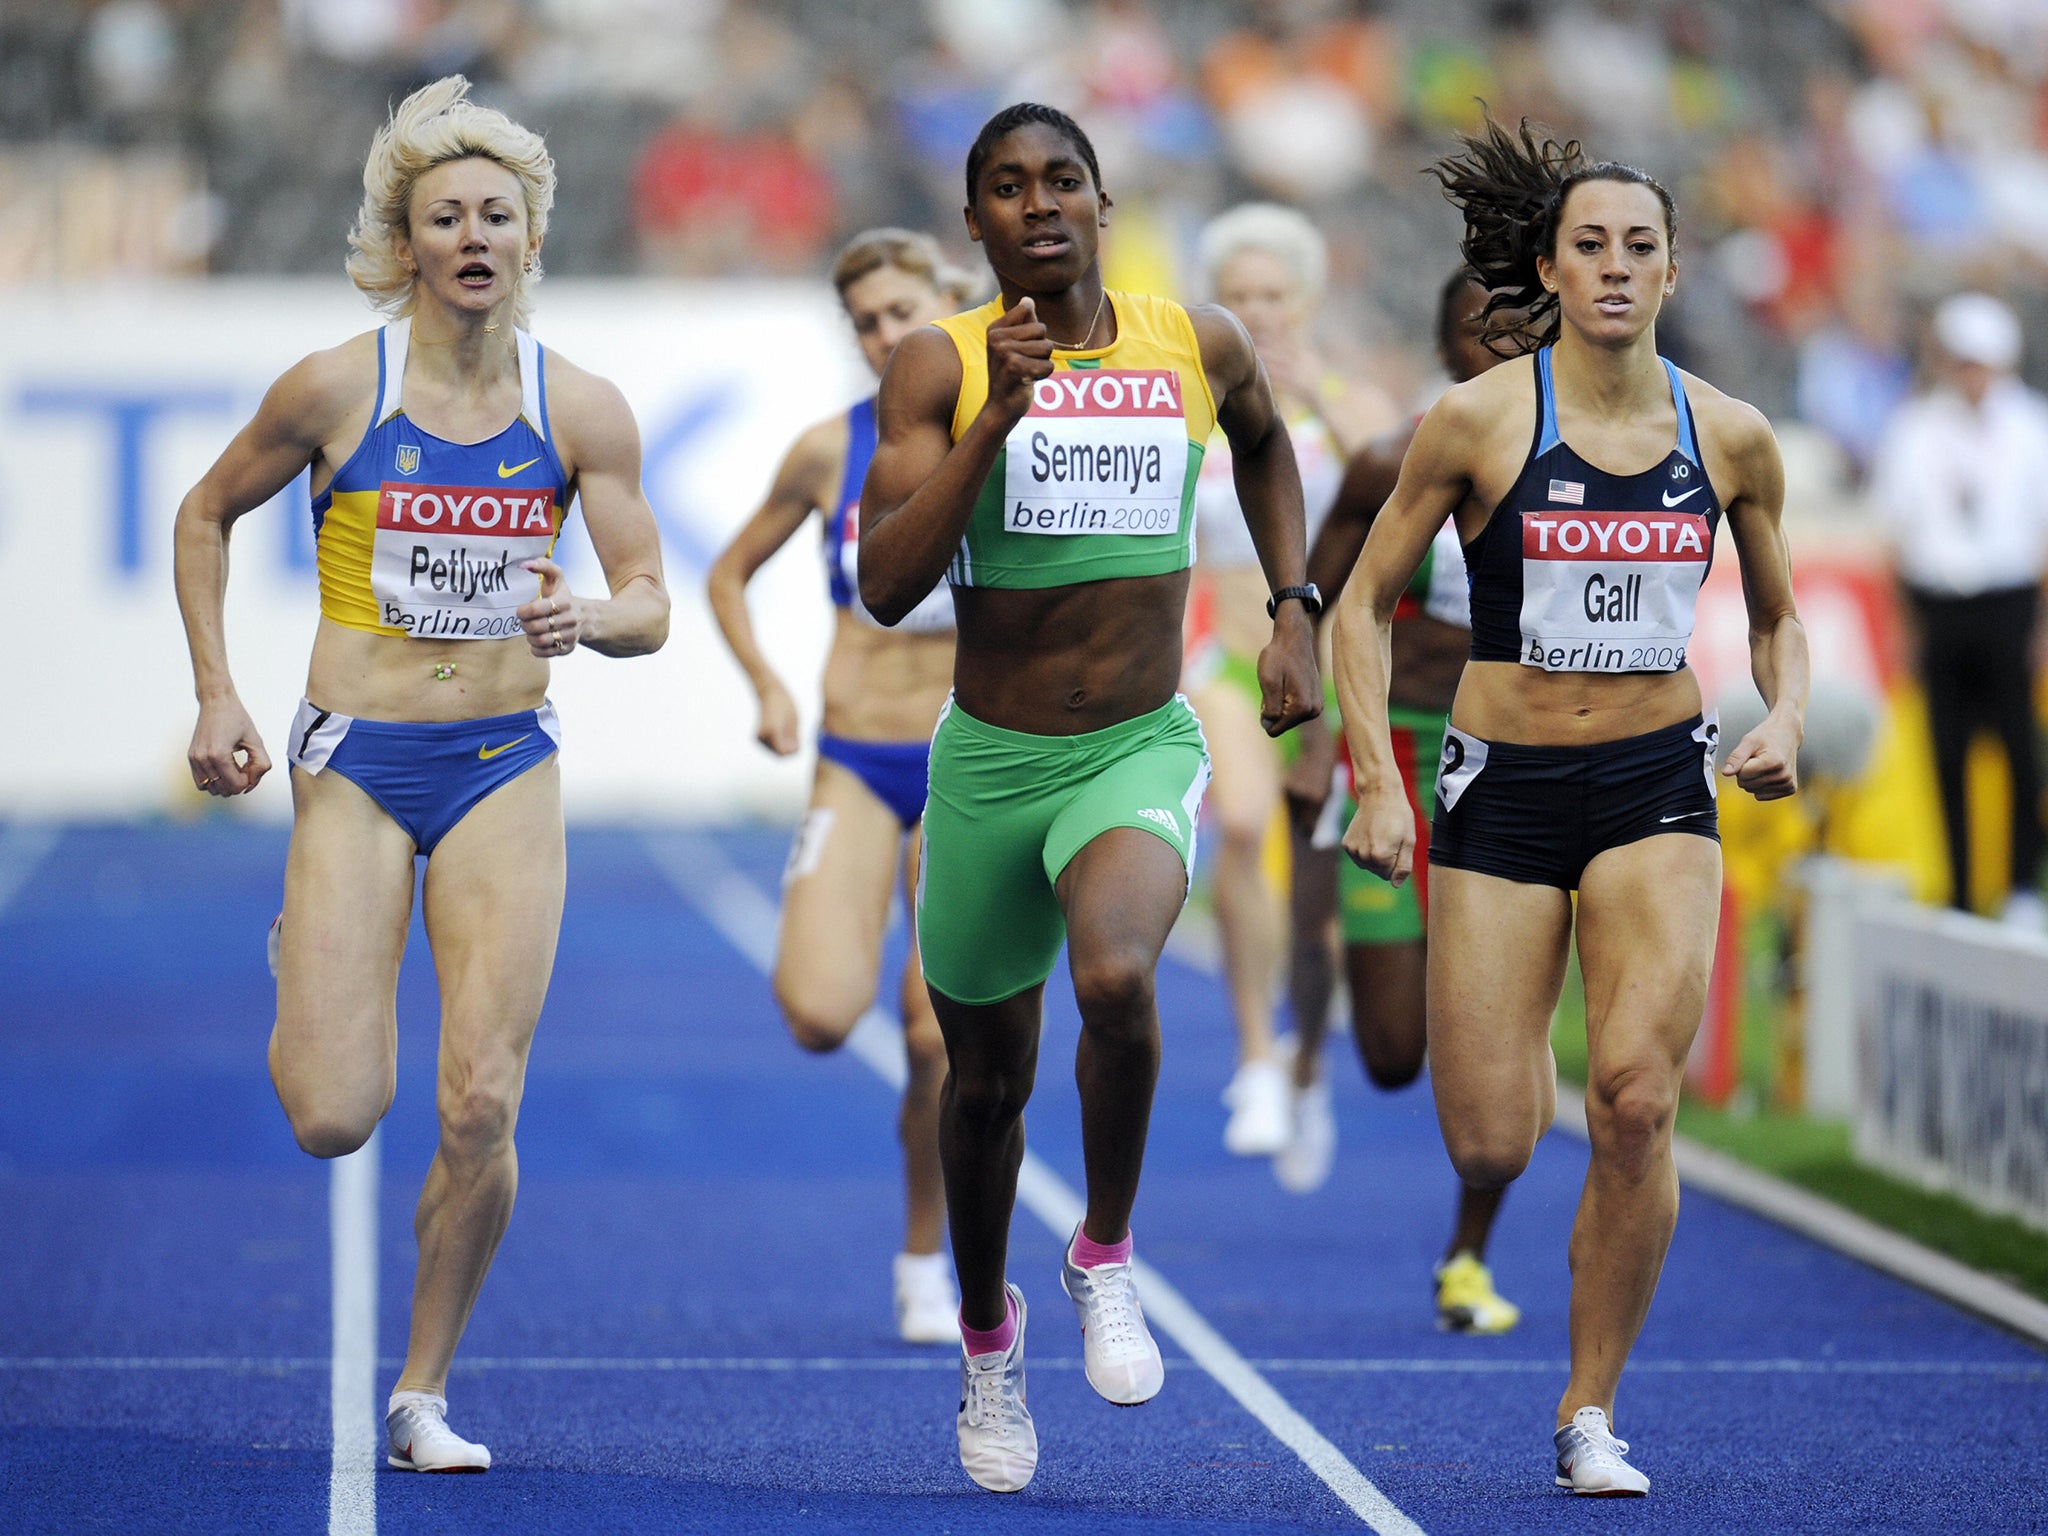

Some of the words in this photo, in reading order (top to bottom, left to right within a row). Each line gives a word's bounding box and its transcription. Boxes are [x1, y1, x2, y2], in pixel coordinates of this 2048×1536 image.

[1034, 376, 1178, 411] OYOTA
[1031, 431, 1161, 494] Semenya
[1671, 464, 1689, 480] JO
[386, 490, 549, 530] TOYOTA
[1012, 501, 1107, 529] berlin
[1112, 508, 1171, 529] 2009
[1530, 519, 1704, 554] TOYOTA
[409, 545, 509, 602] Petlyuk
[1583, 572, 1642, 624] Gall
[384, 602, 471, 636] berlin
[1529, 639, 1624, 669] berlin
[1628, 646, 1687, 669] 2009
